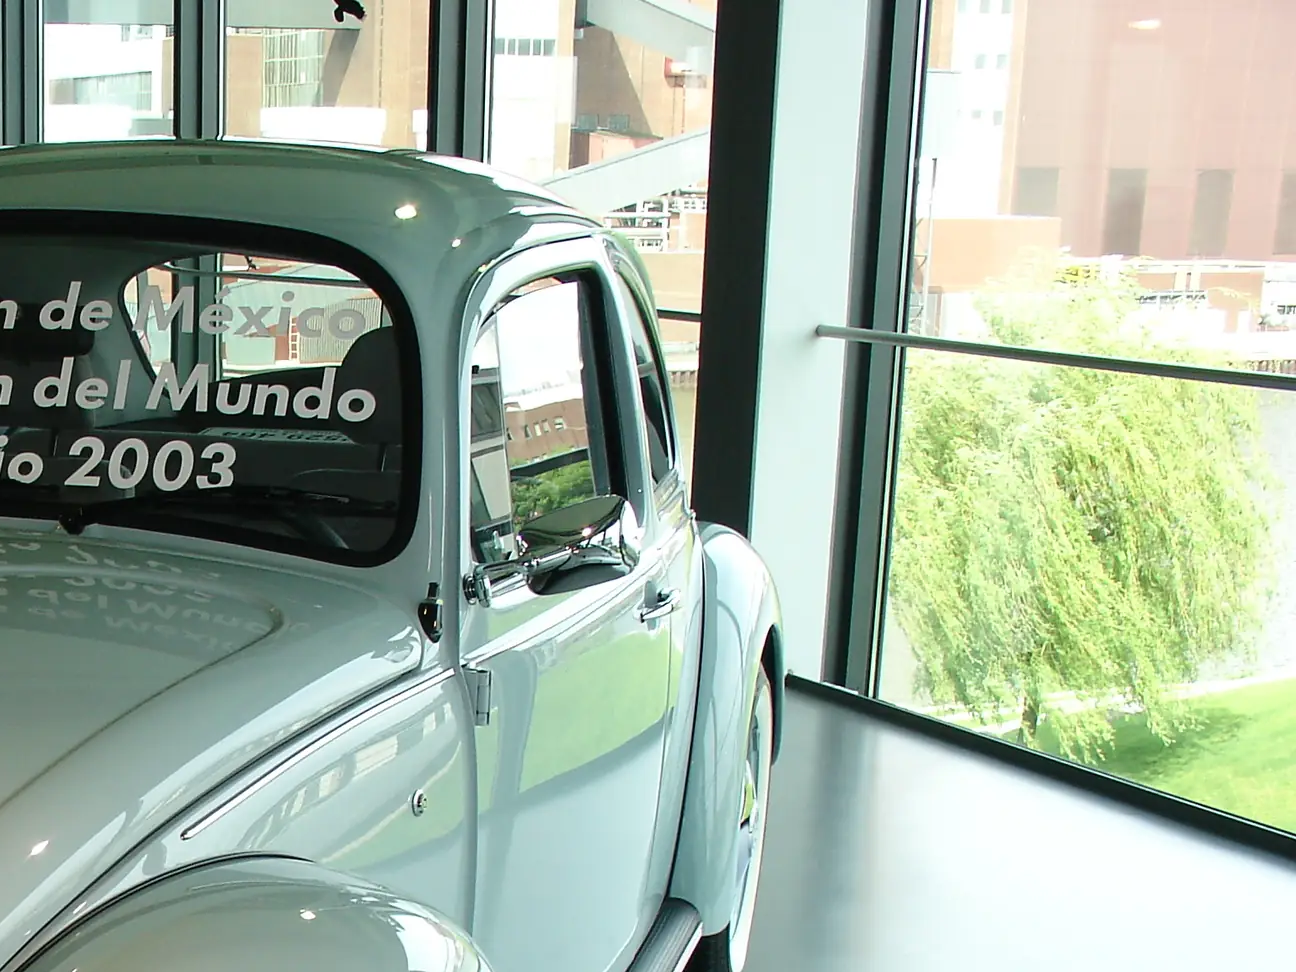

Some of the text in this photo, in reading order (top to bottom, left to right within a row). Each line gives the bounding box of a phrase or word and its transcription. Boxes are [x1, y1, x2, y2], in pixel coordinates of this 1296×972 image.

[39, 281, 113, 331] de
[132, 284, 367, 341] México
[32, 356, 133, 411] del
[145, 361, 377, 423] Mundo
[63, 435, 238, 492] 2003
